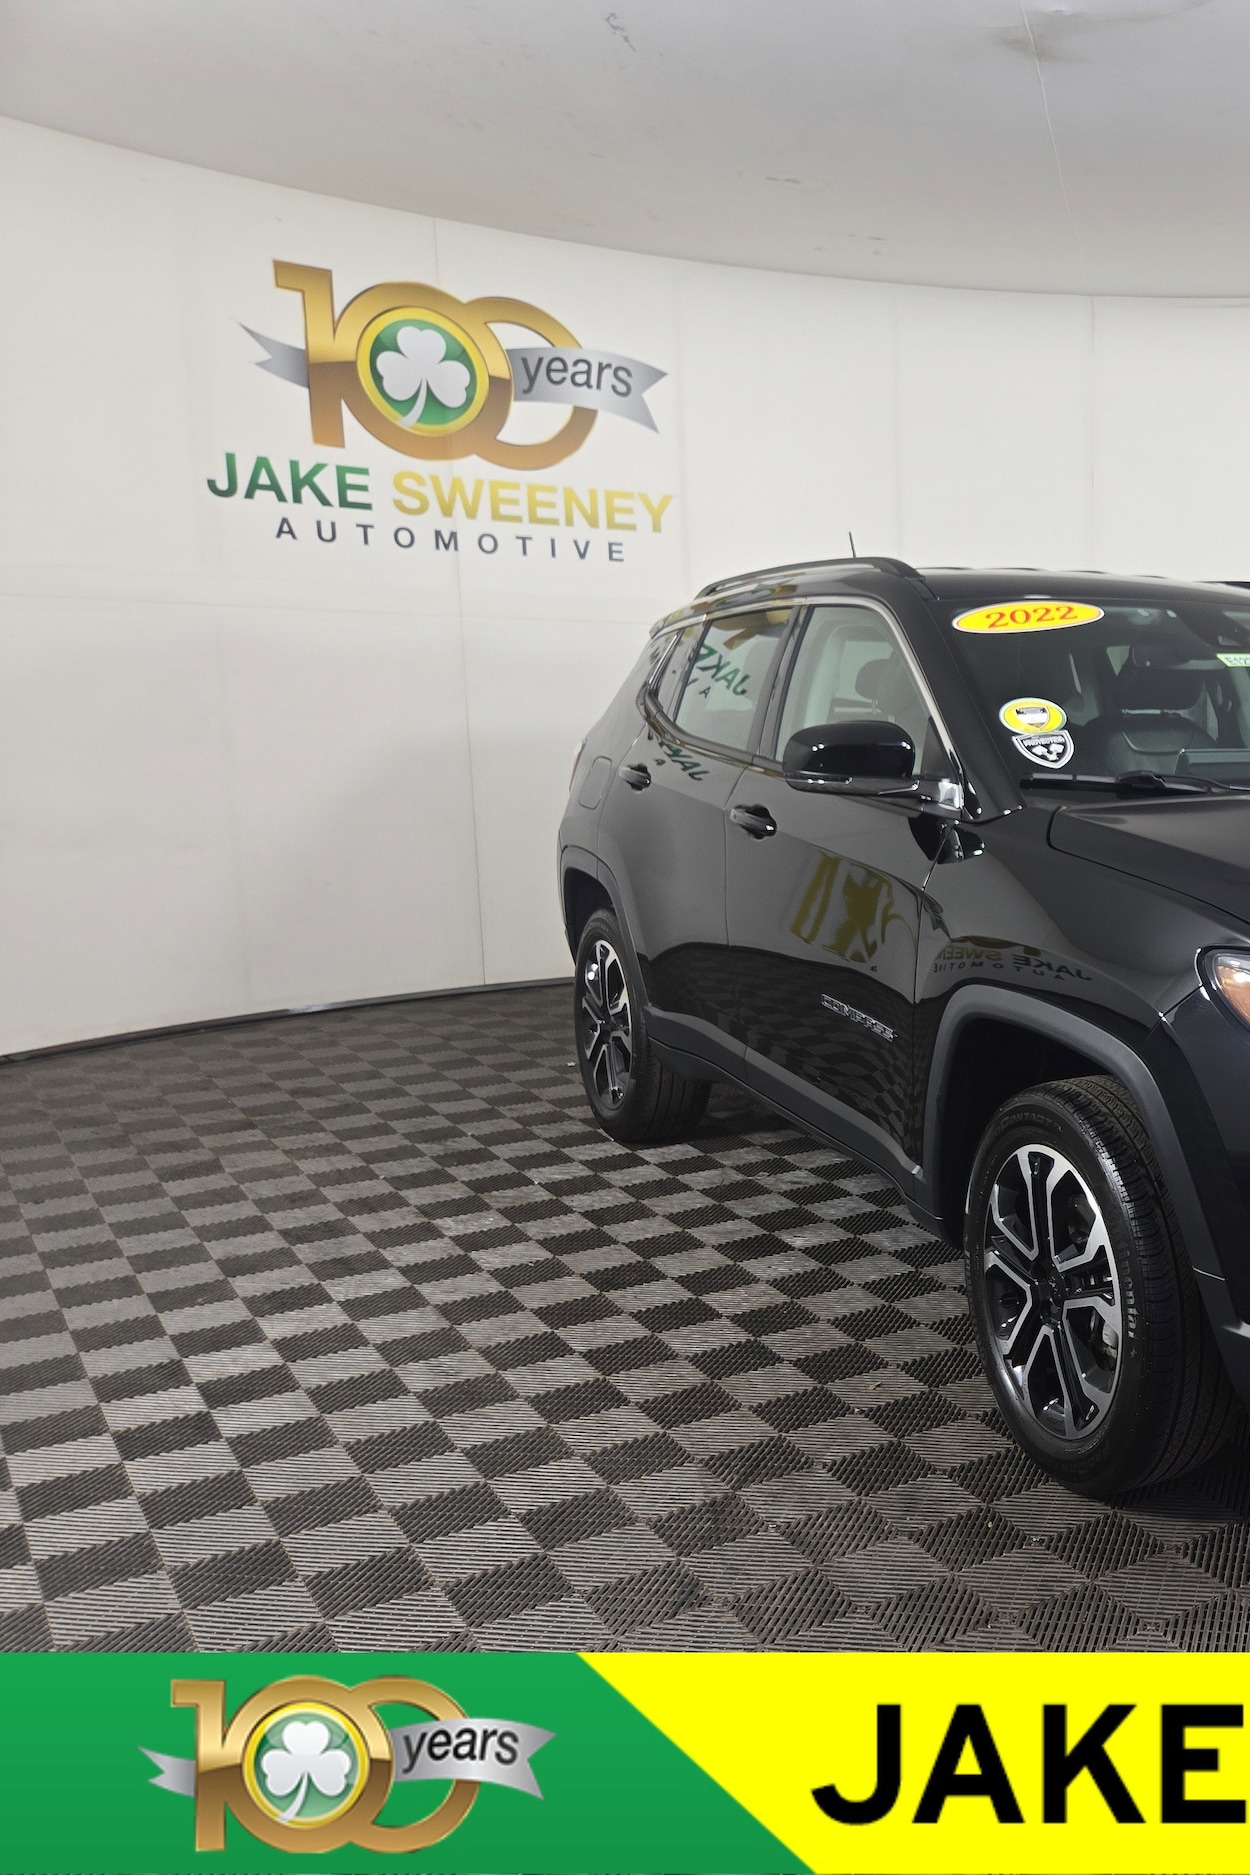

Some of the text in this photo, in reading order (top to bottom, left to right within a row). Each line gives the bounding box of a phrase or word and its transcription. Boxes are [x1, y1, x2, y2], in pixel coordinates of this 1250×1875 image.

[520, 352, 634, 399] years
[205, 451, 674, 534] JAKE SWEENEY
[275, 515, 627, 563] AUTOMOTIVE
[985, 605, 1079, 629] 2022
